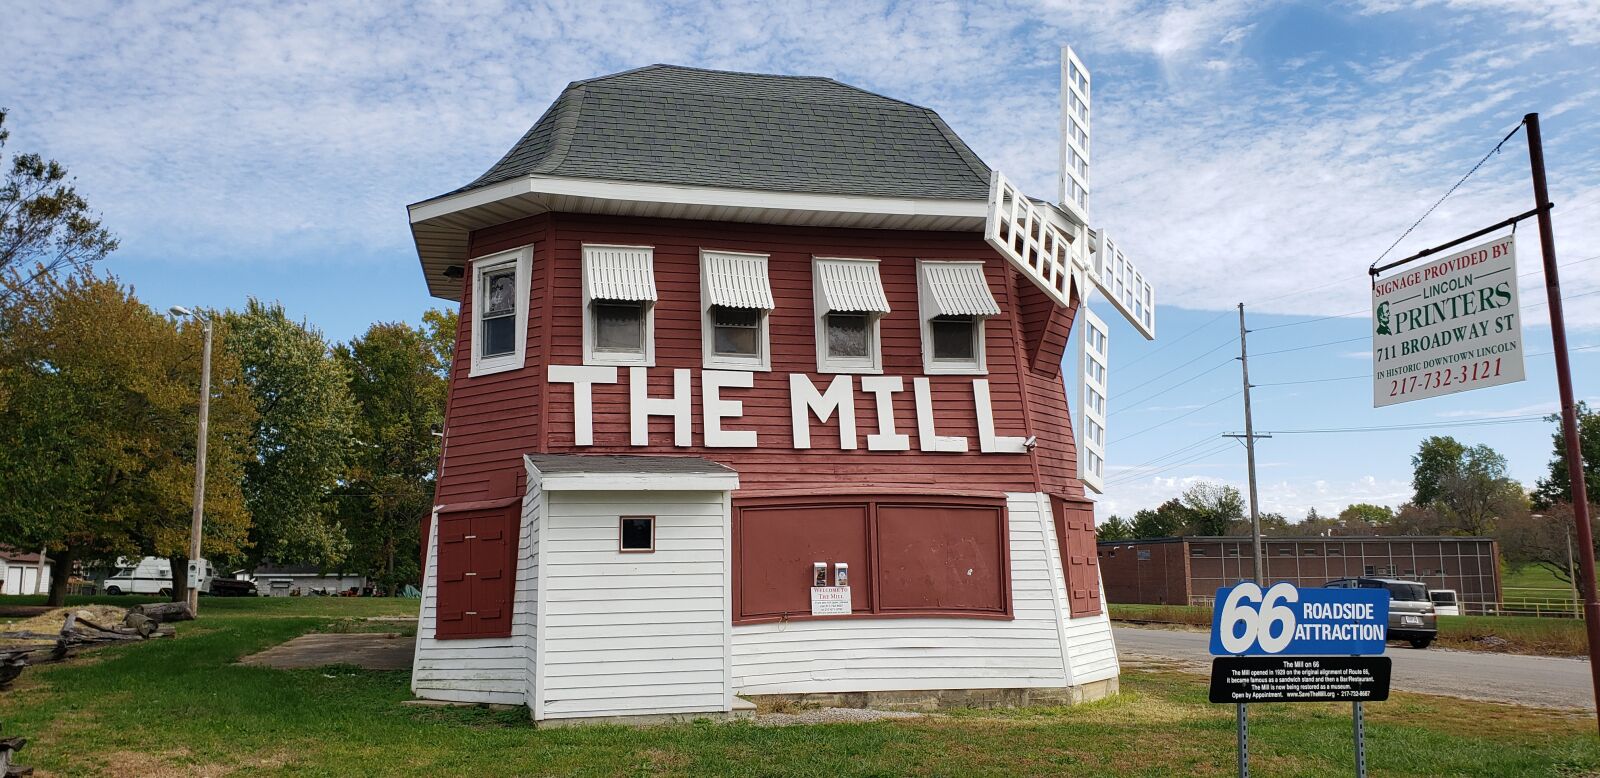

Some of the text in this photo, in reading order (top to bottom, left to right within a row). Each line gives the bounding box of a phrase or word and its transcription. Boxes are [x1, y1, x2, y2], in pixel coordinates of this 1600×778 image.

[1376, 272, 1422, 298] SIGNAGE
[1424, 249, 1488, 280] PROVIDED
[1423, 274, 1473, 299] LINCOLN
[1394, 281, 1512, 334] PRINTERS
[1377, 314, 1514, 362] 711 BROADWAY ST
[1378, 340, 1517, 380] IN HISTORIC DOWNTOWN LINCOLN
[1390, 358, 1502, 396] 217-732-3121
[548, 365, 1027, 453] THE MILL
[1220, 582, 1298, 654] 66
[1294, 624, 1384, 640] ATTRACTION
[1303, 602, 1374, 620] ROADSIDE
